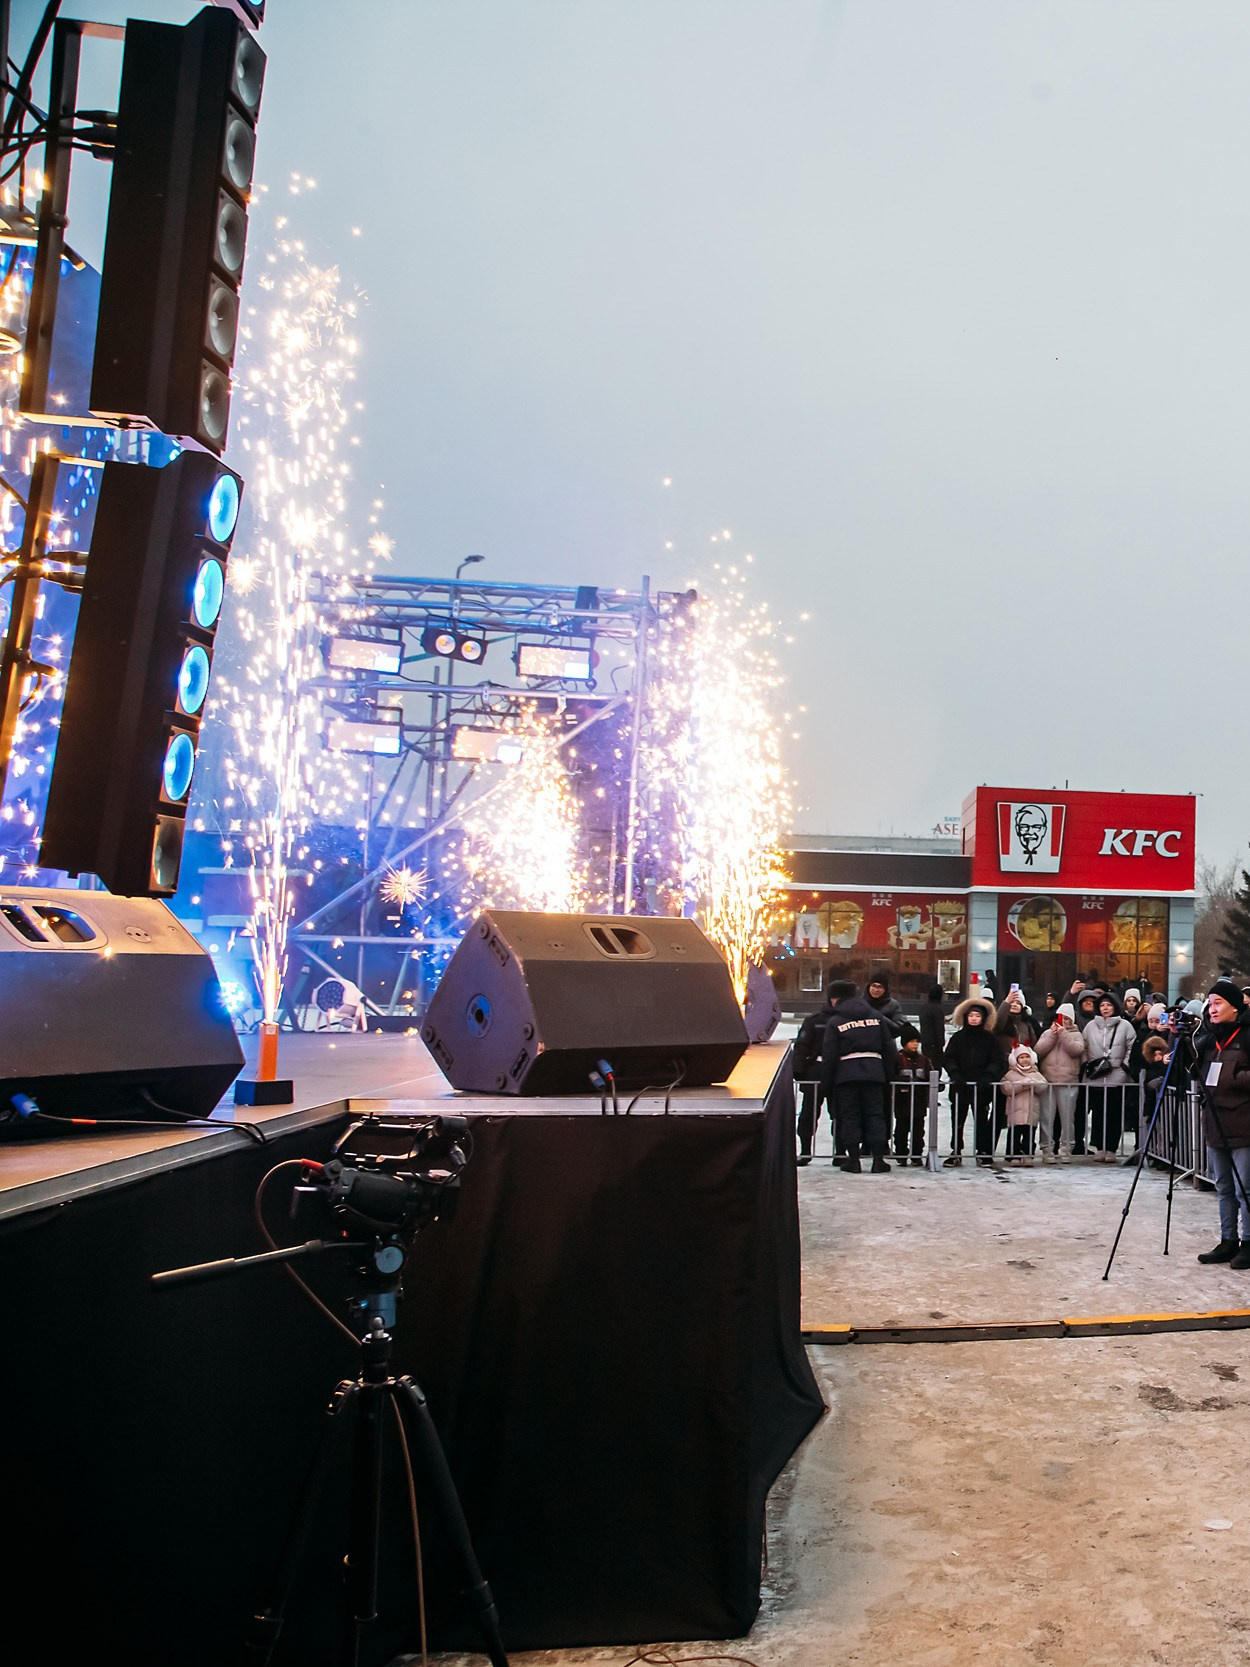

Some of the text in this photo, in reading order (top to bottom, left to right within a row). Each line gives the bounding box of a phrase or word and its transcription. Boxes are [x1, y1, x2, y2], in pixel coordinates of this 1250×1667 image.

[1098, 828, 1182, 858] KFC
[871, 898, 893, 906] KFC
[1082, 901, 1105, 910] KFC
